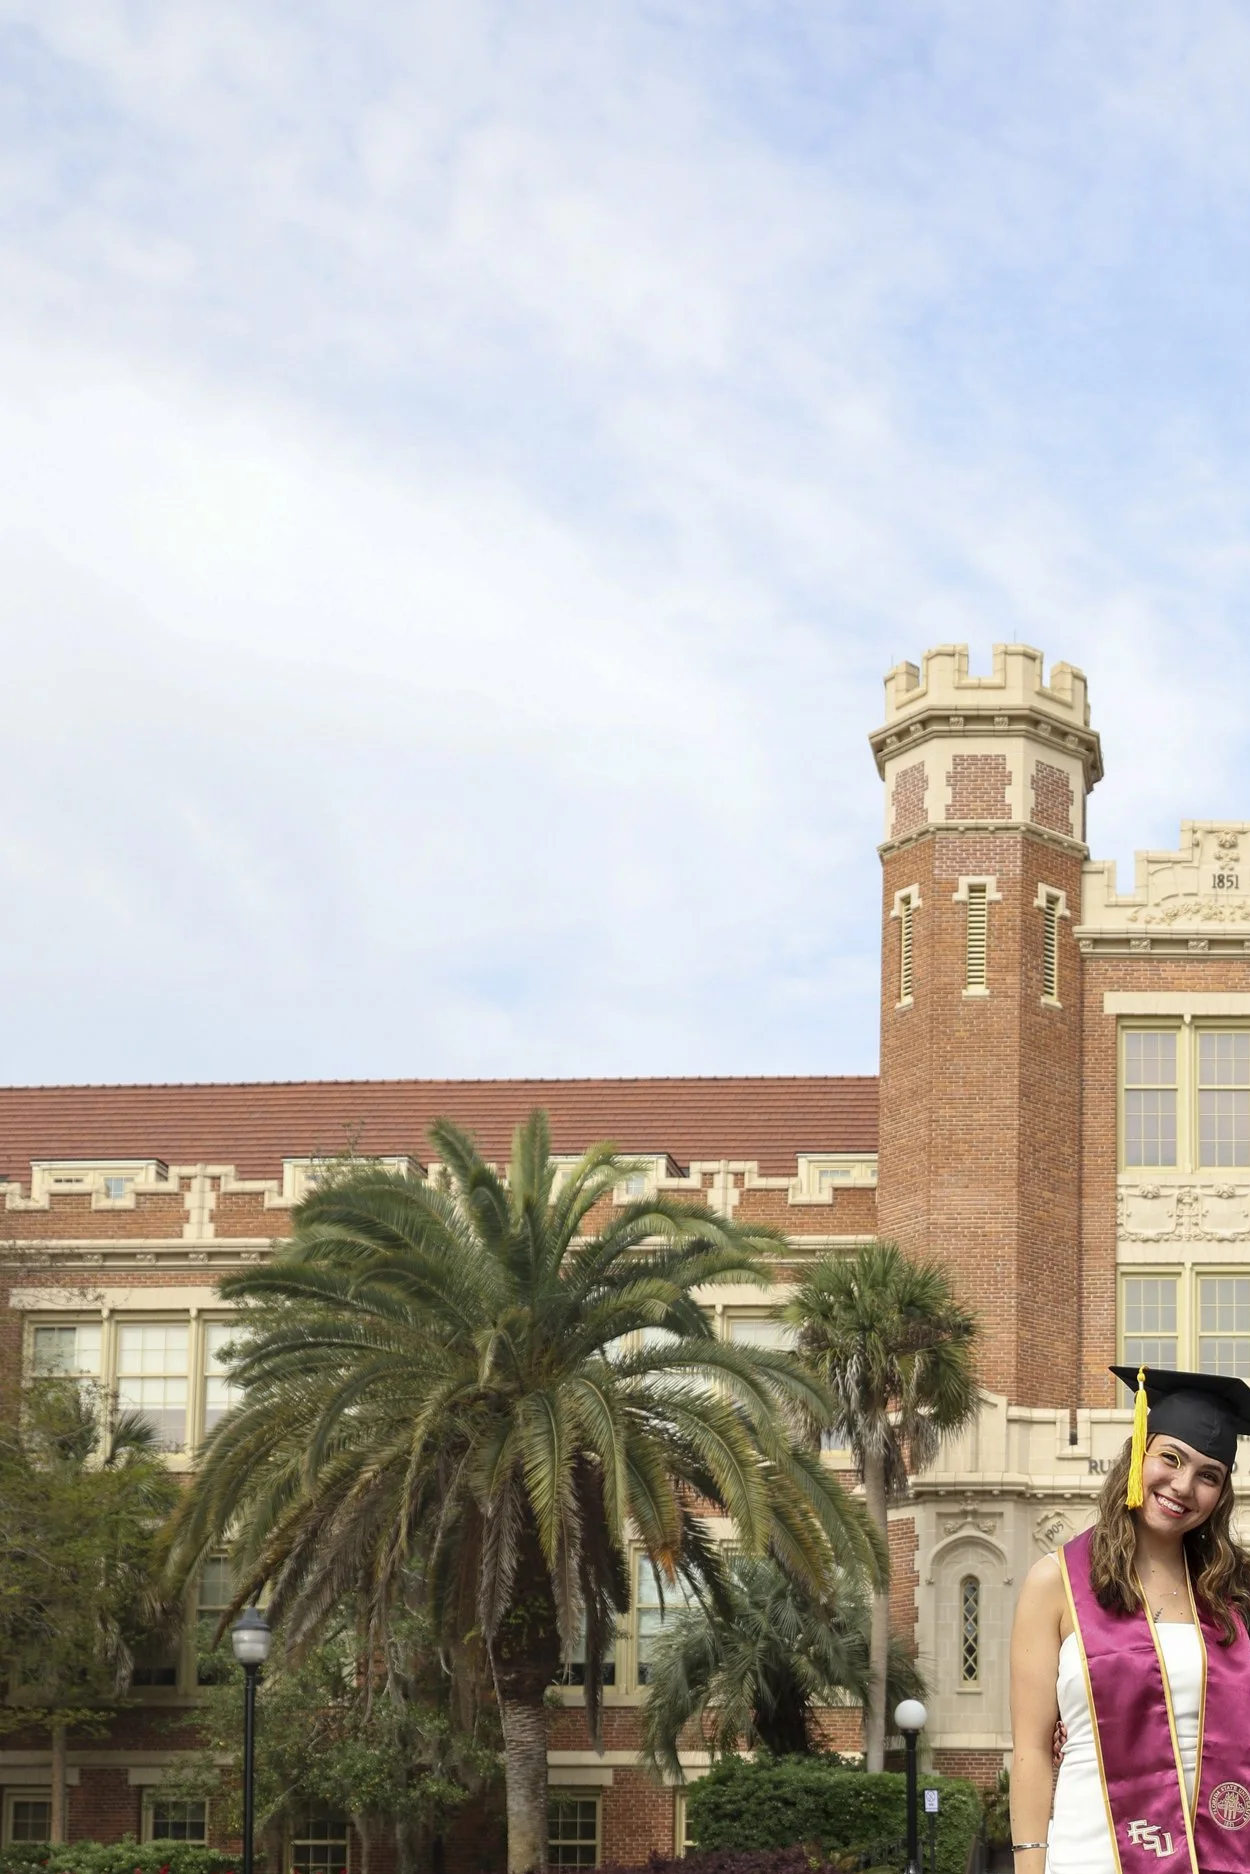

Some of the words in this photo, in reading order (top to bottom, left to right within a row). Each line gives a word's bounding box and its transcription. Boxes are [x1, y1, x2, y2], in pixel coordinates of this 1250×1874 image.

[1211, 873, 1240, 890] 1851
[1045, 1520, 1064, 1541] 1905
[1127, 1819, 1176, 1858] FSU
